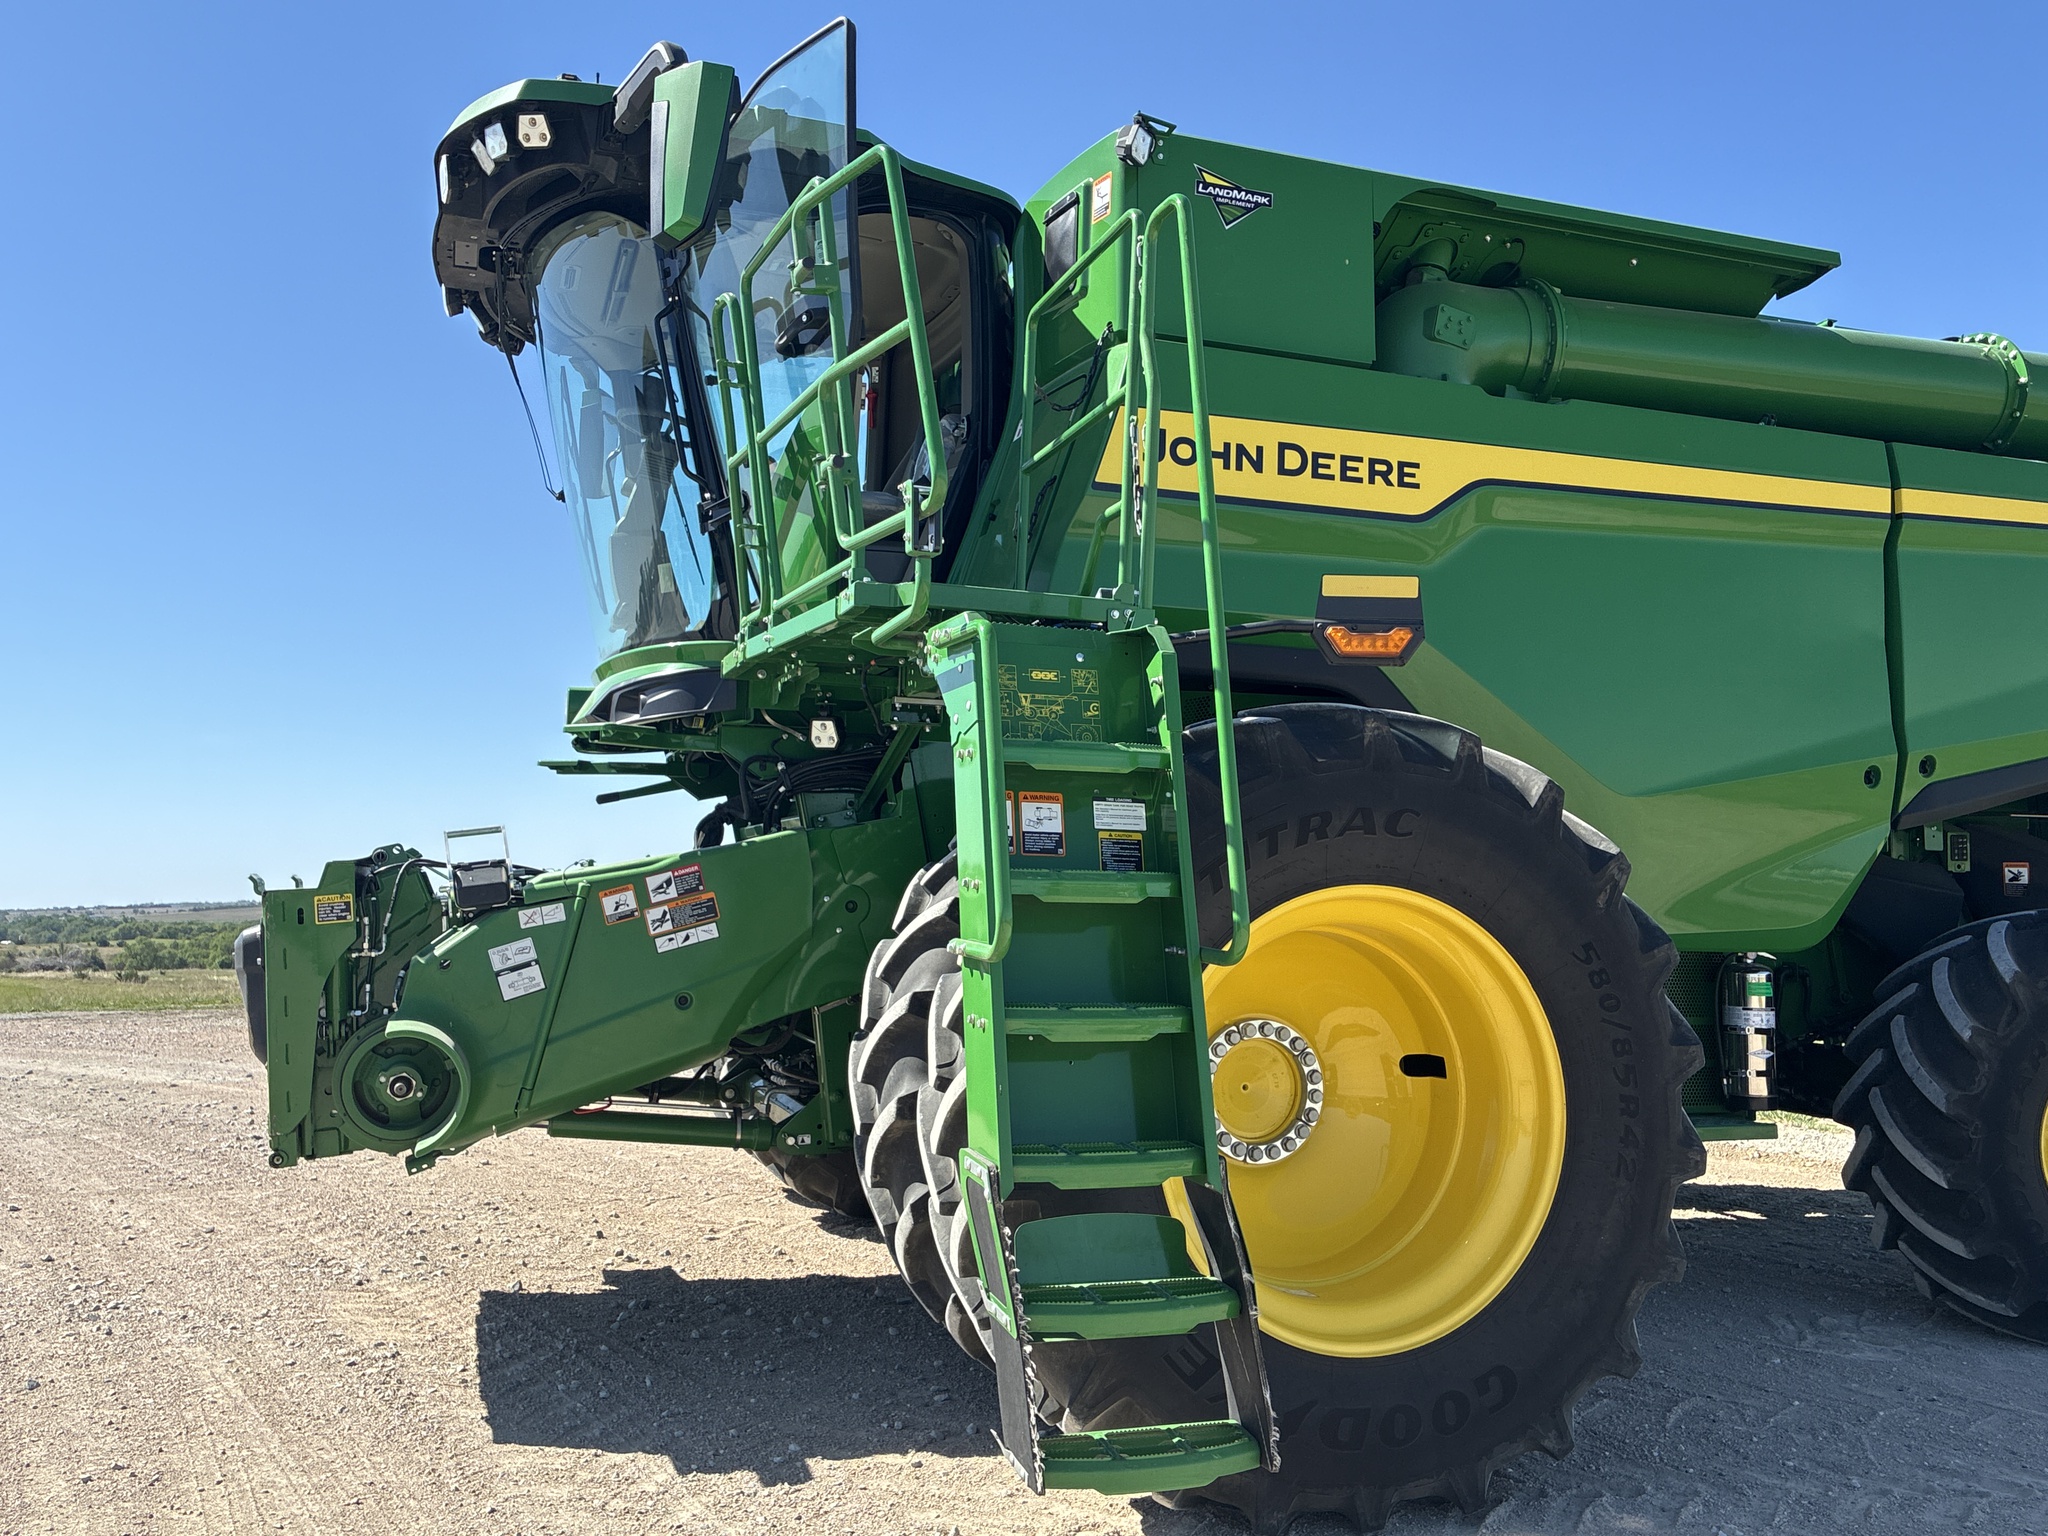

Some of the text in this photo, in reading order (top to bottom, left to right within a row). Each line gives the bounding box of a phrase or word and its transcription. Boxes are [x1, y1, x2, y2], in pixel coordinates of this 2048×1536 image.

[1198, 183, 1270, 205] LANDMARK
[1216, 196, 1255, 209] IMPLEMENT
[1143, 428, 1421, 490] JOHN DEERE
[1029, 794, 1060, 802] WARNING
[678, 866, 699, 875] DANGER
